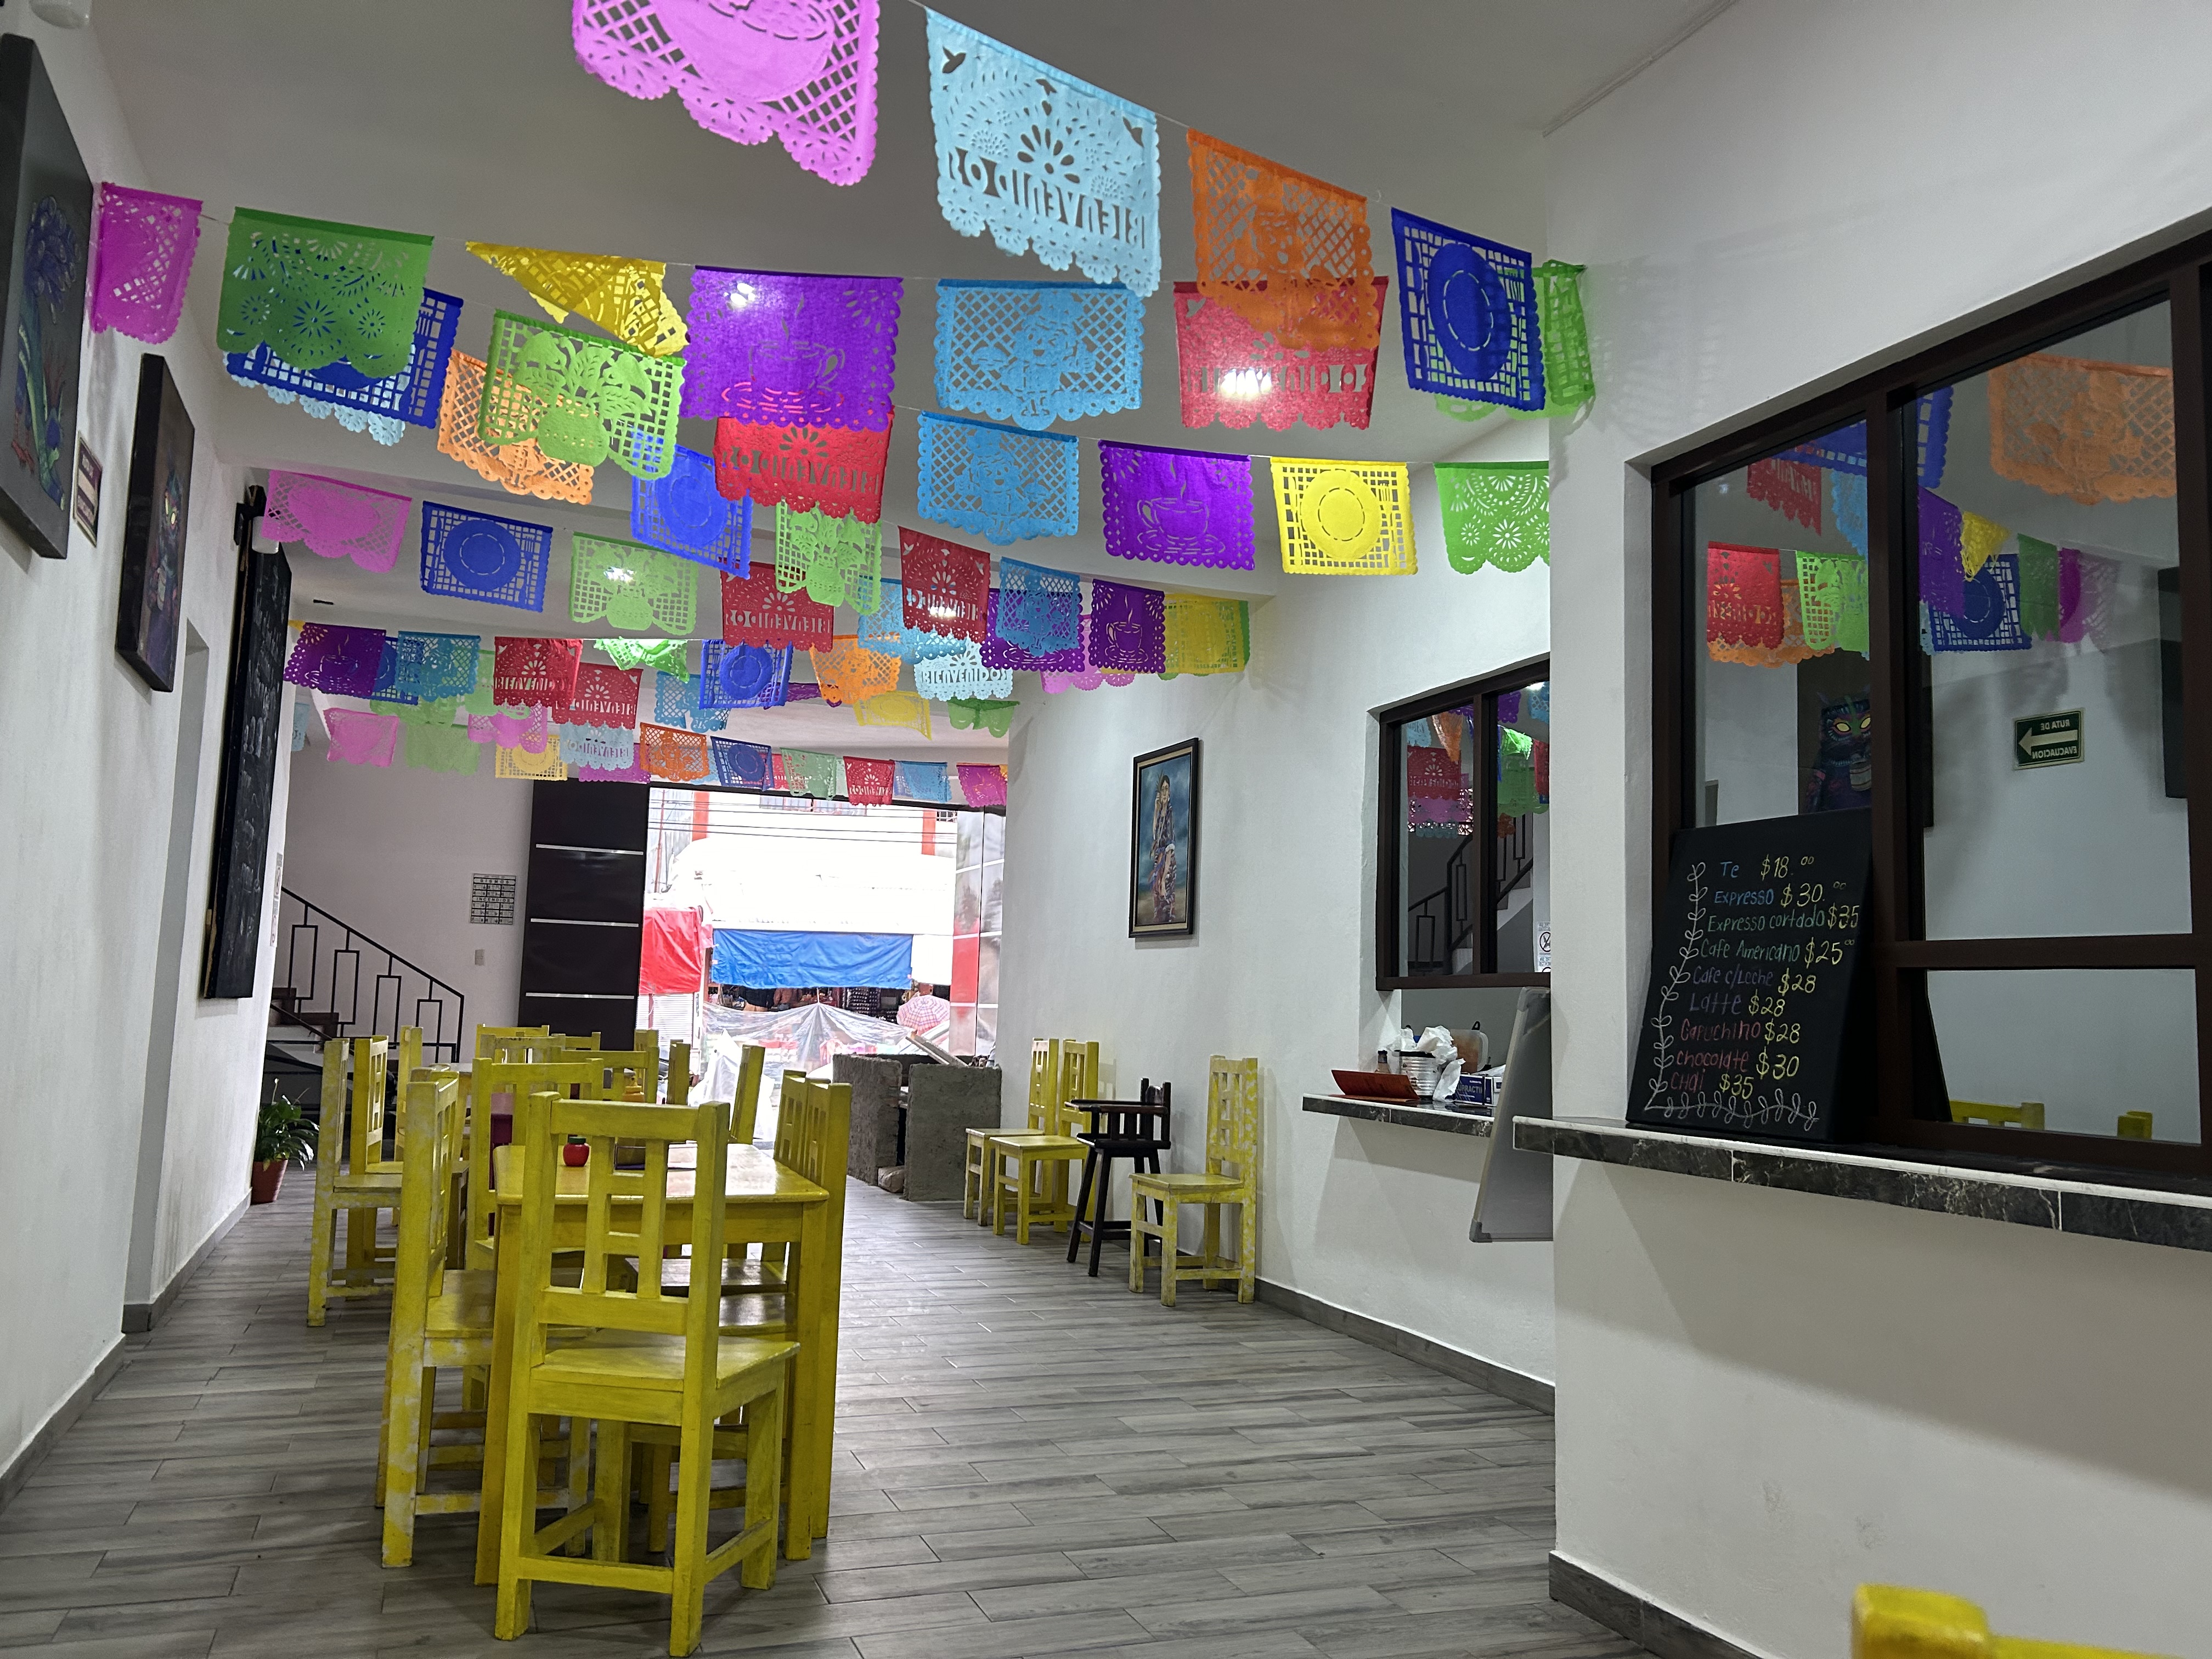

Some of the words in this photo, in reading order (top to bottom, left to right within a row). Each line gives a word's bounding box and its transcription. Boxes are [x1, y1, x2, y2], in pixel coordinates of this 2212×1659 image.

[1187, 364, 1368, 393] BIENVENIDOS
[921, 668, 1008, 684] BIENVENIDOS
[1720, 861, 1740, 878] Te
[1769, 904, 1825, 929] cortado
[1827, 902, 1860, 930] $35
[1701, 938, 1730, 958] Cafe
[1736, 939, 1801, 962] Americano
[1804, 936, 1843, 969] $25
[1692, 965, 1722, 985] Cafe
[1778, 967, 1816, 996] $28
[1689, 992, 1742, 1015] Latte
[1748, 989, 1785, 1017] $28
[1764, 1018, 1801, 1045] $28
[1756, 1046, 1799, 1080] $30
[1719, 1070, 1754, 1100] $35
